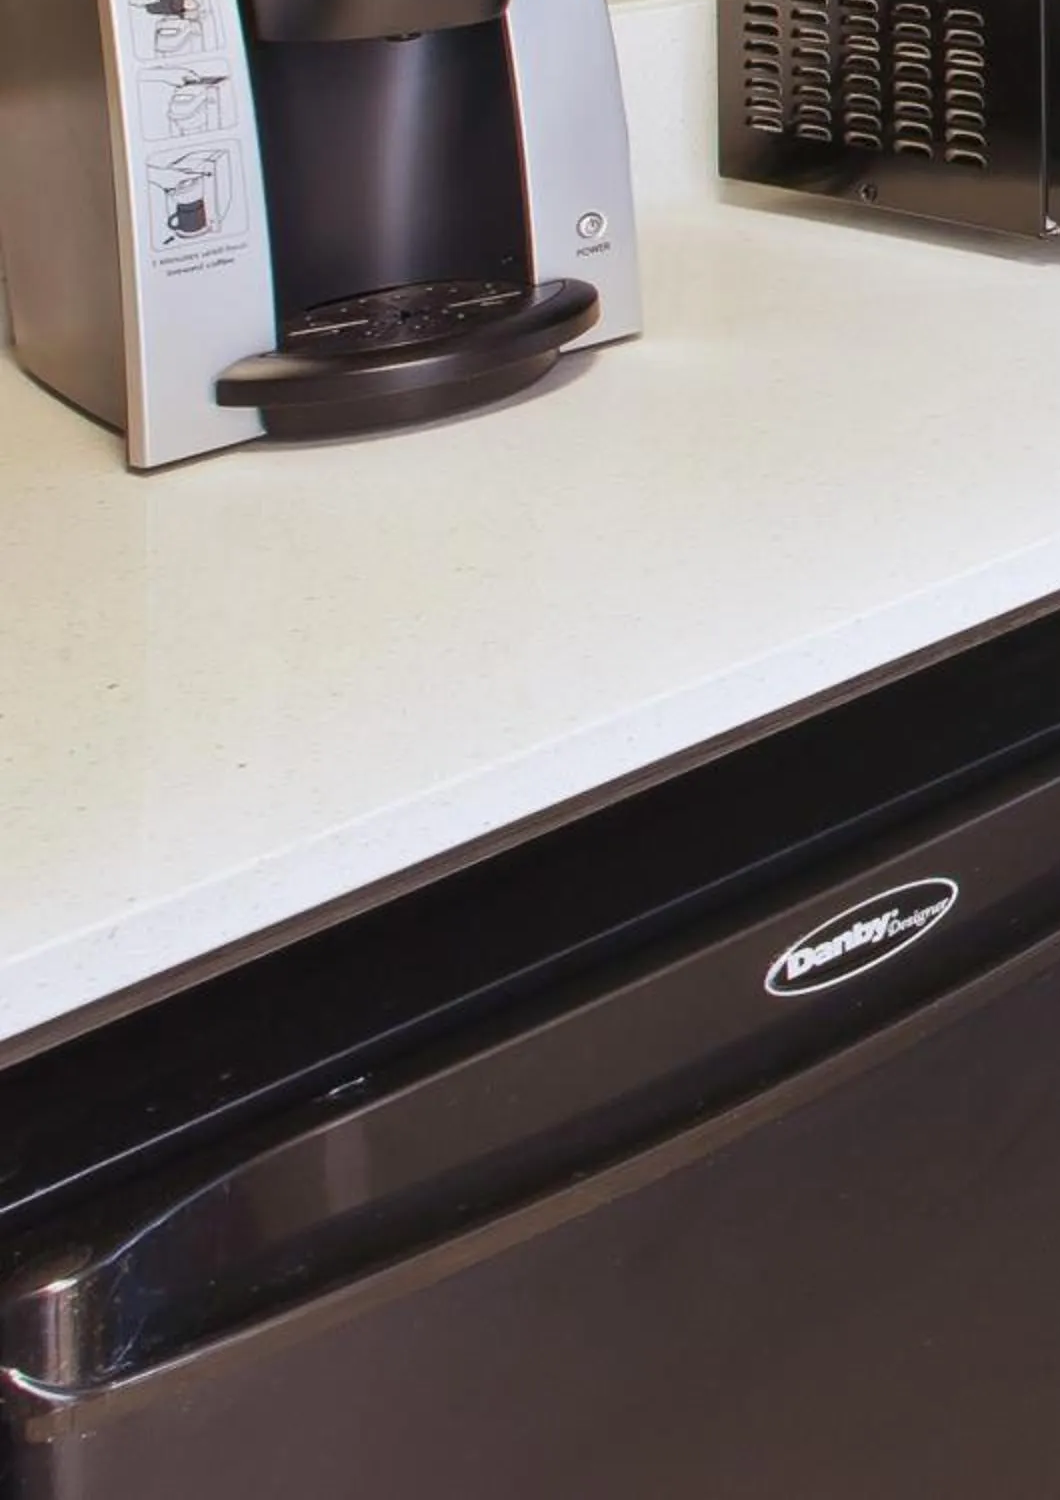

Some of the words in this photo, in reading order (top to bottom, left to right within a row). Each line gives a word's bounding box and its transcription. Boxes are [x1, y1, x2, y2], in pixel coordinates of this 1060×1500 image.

[577, 241, 611, 257] POWER
[786, 910, 894, 980] Danby
[887, 897, 949, 937] Designer
